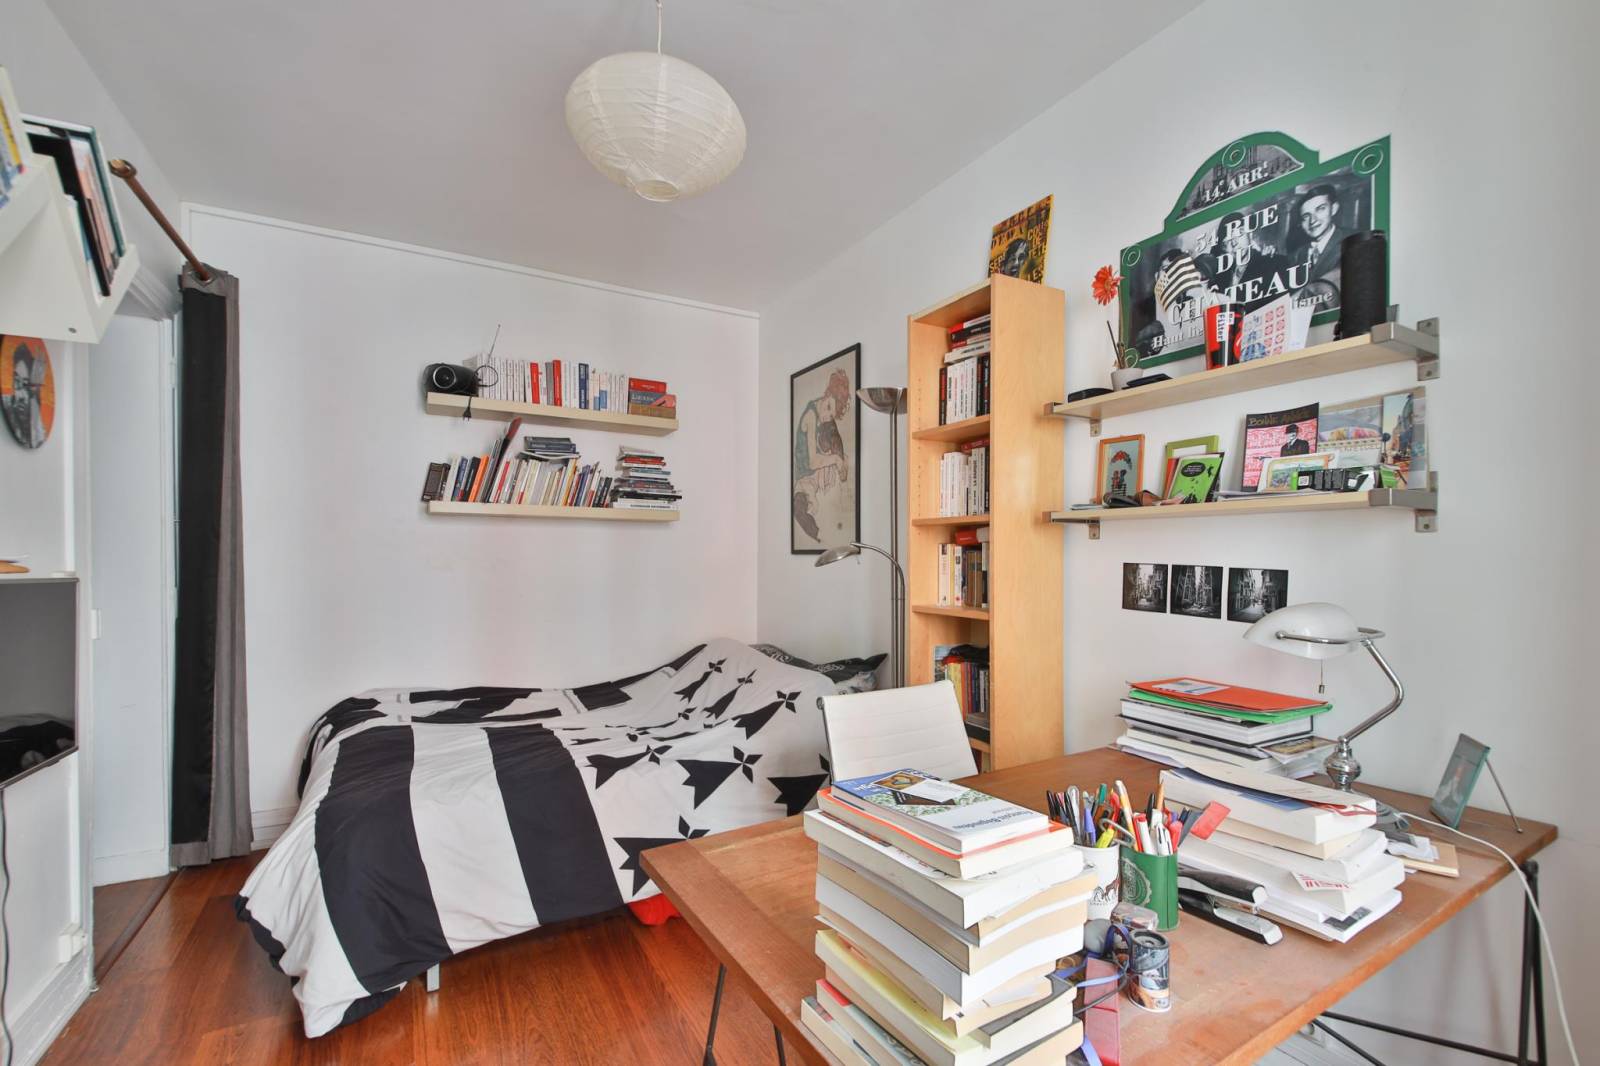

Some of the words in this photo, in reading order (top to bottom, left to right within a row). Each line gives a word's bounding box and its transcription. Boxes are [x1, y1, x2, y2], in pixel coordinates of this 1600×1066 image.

[1195, 229, 1219, 252] 54
[1223, 204, 1279, 242] RUE
[1215, 245, 1252, 275] DU
[1217, 313, 1226, 340] Filter
